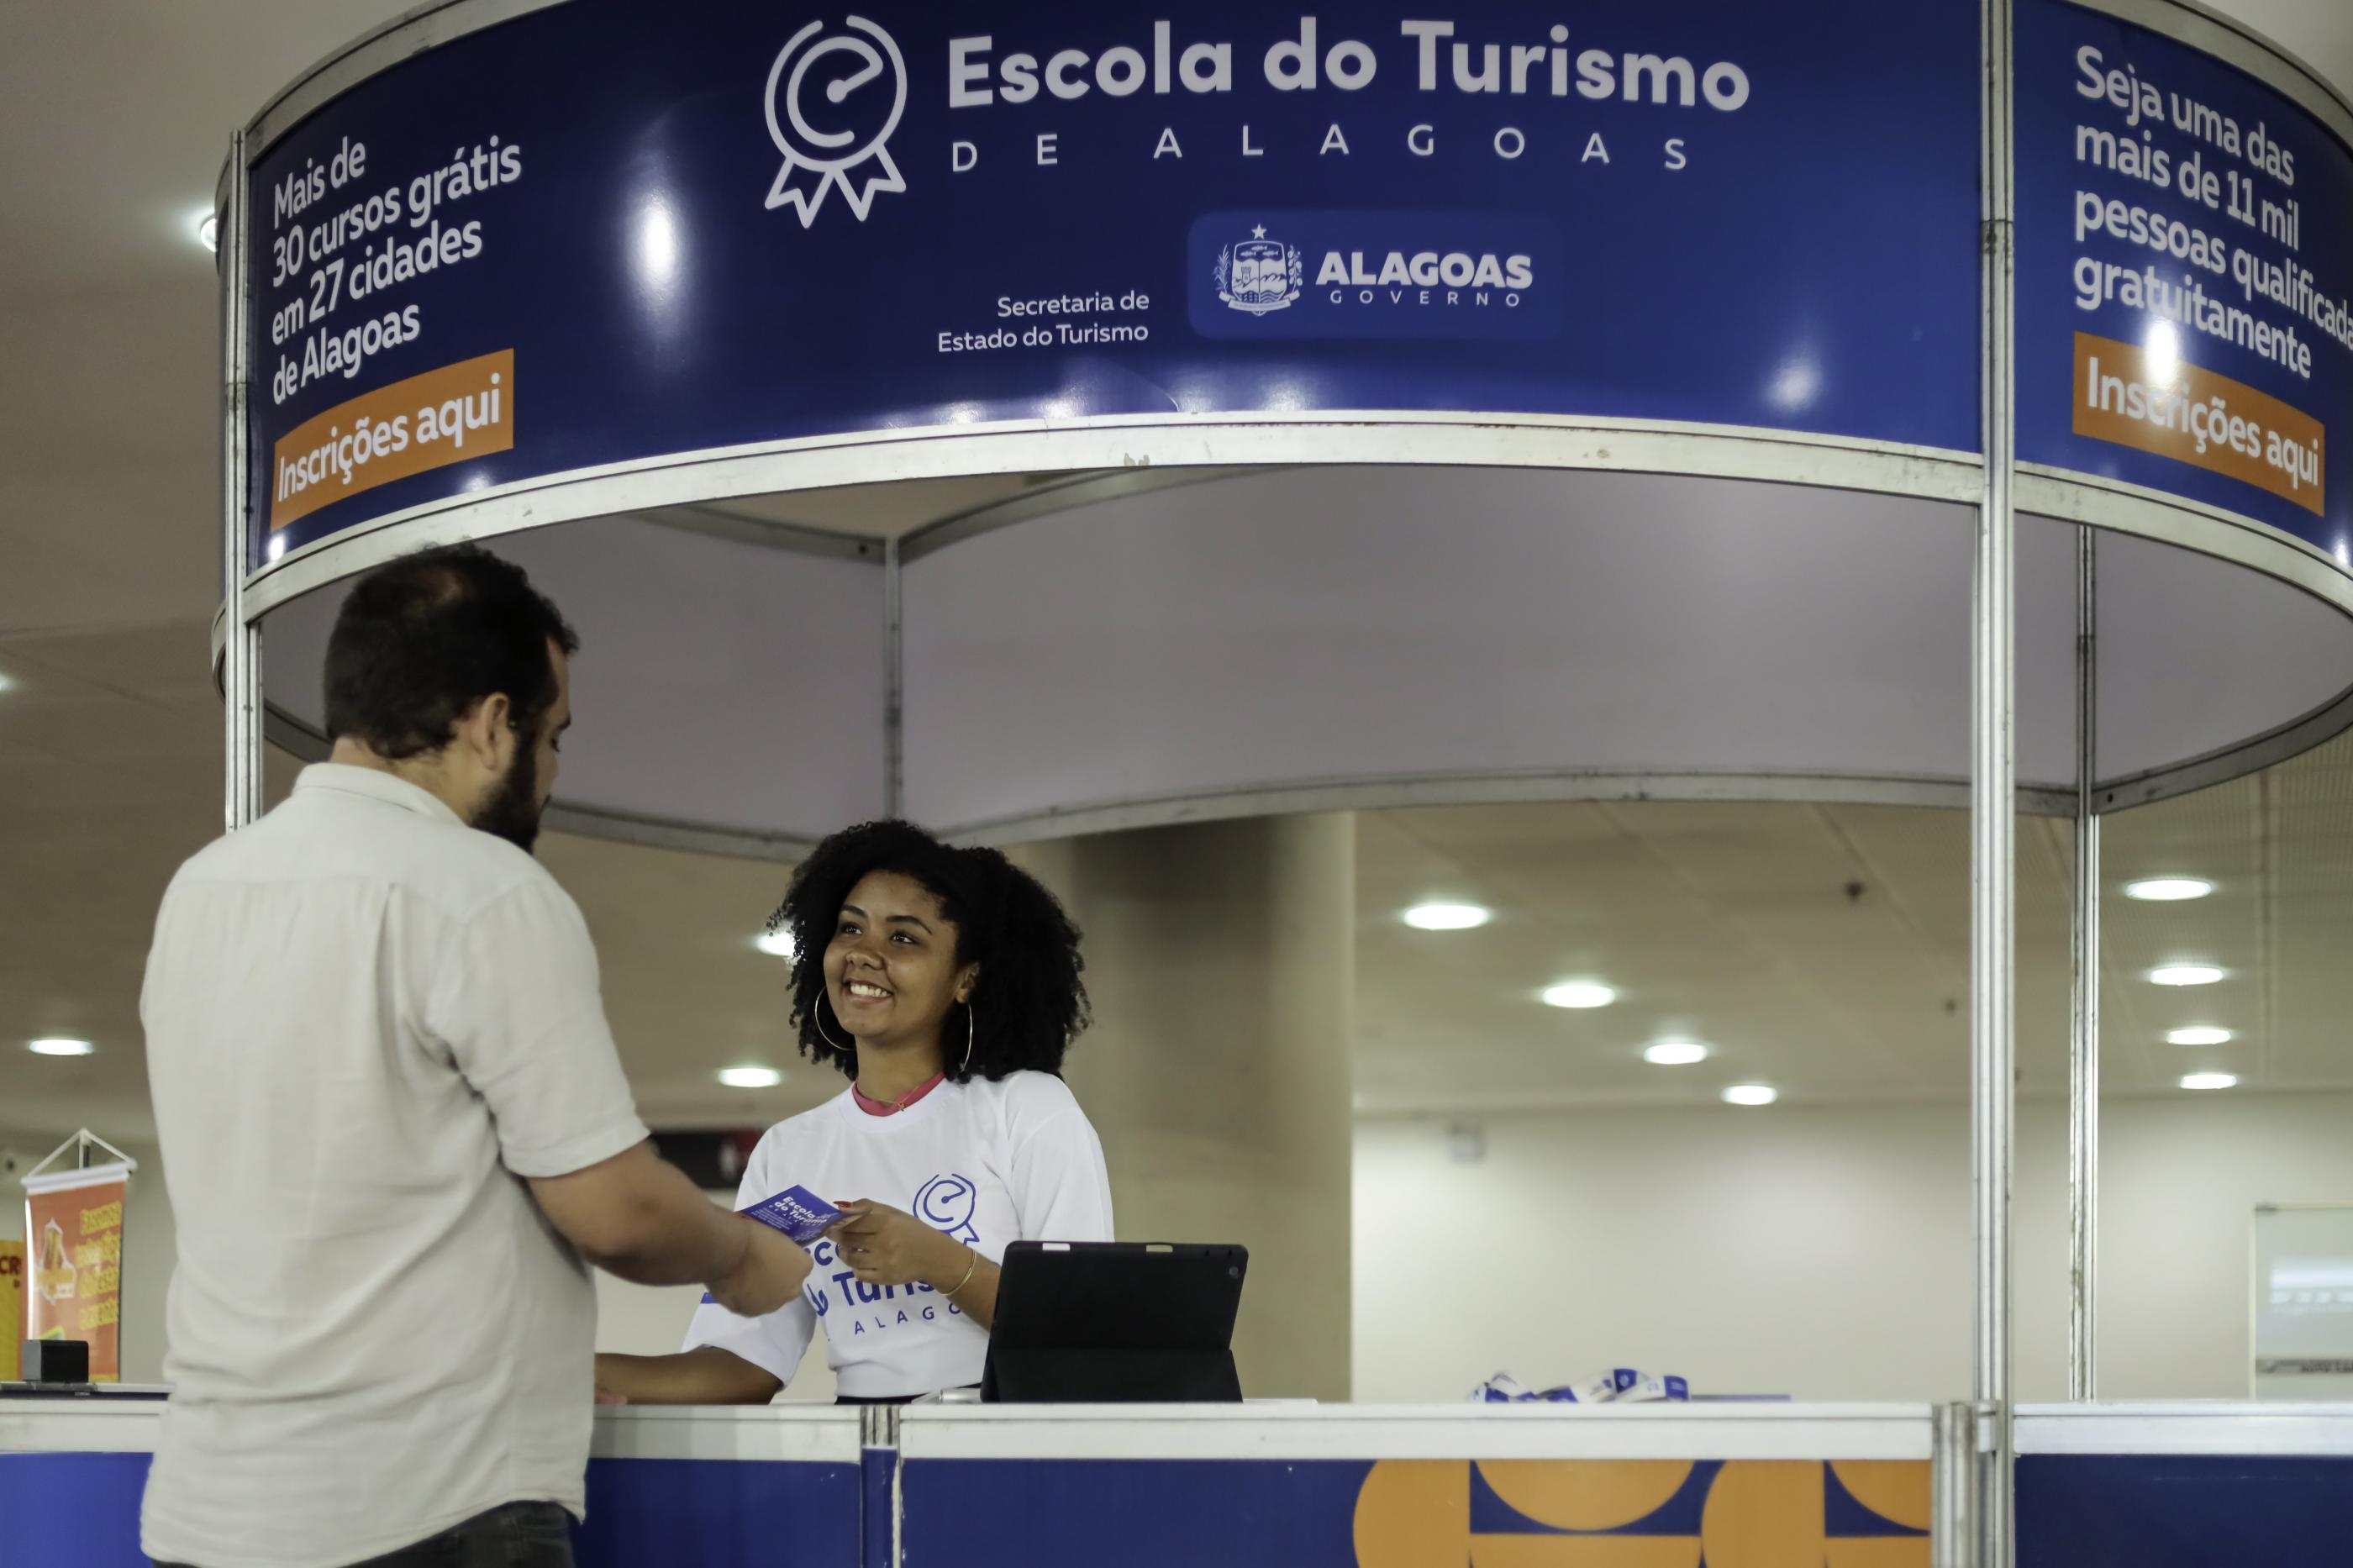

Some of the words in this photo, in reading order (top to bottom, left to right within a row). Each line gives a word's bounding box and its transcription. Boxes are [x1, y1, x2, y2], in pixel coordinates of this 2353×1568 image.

[950, 20, 1232, 108] Escola
[1264, 16, 1377, 91] do
[1401, 20, 1750, 111] Turismo
[953, 134, 1057, 171] DE
[1154, 124, 1687, 170] ALAGOAS
[2076, 45, 2164, 126] Seja
[2172, 92, 2240, 158] uma
[2247, 122, 2294, 186] das
[273, 225, 304, 287] 30
[308, 187, 401, 262] cursos
[408, 135, 521, 227] grátis
[274, 158, 325, 229] Mais
[330, 136, 366, 189] de
[2077, 124, 2170, 187] mais
[2179, 151, 2219, 209] de
[2227, 170, 2256, 227] 11
[2261, 194, 2298, 251] mil
[1315, 251, 1534, 290] ALAGOAS
[2076, 190, 2225, 274] pessoas
[272, 297, 304, 345] em
[309, 259, 345, 323] 27
[349, 218, 482, 300] cidades
[998, 292, 1114, 318] Secretaria
[1120, 290, 1150, 311] de
[1329, 290, 1519, 308] GOVERNO
[2074, 256, 2311, 379] gratuitamente
[273, 355, 297, 405] de
[301, 303, 420, 389] Alagoas
[938, 329, 1018, 352] Estado
[1023, 325, 1053, 347] do
[1055, 323, 1149, 345] Turismo
[278, 416, 409, 502] Inscrições
[416, 372, 500, 448] aqui
[2087, 356, 2261, 460] Inscrições
[2267, 429, 2319, 490] aqui
[774, 1202, 788, 1211] do
[782, 1196, 817, 1219] Escola
